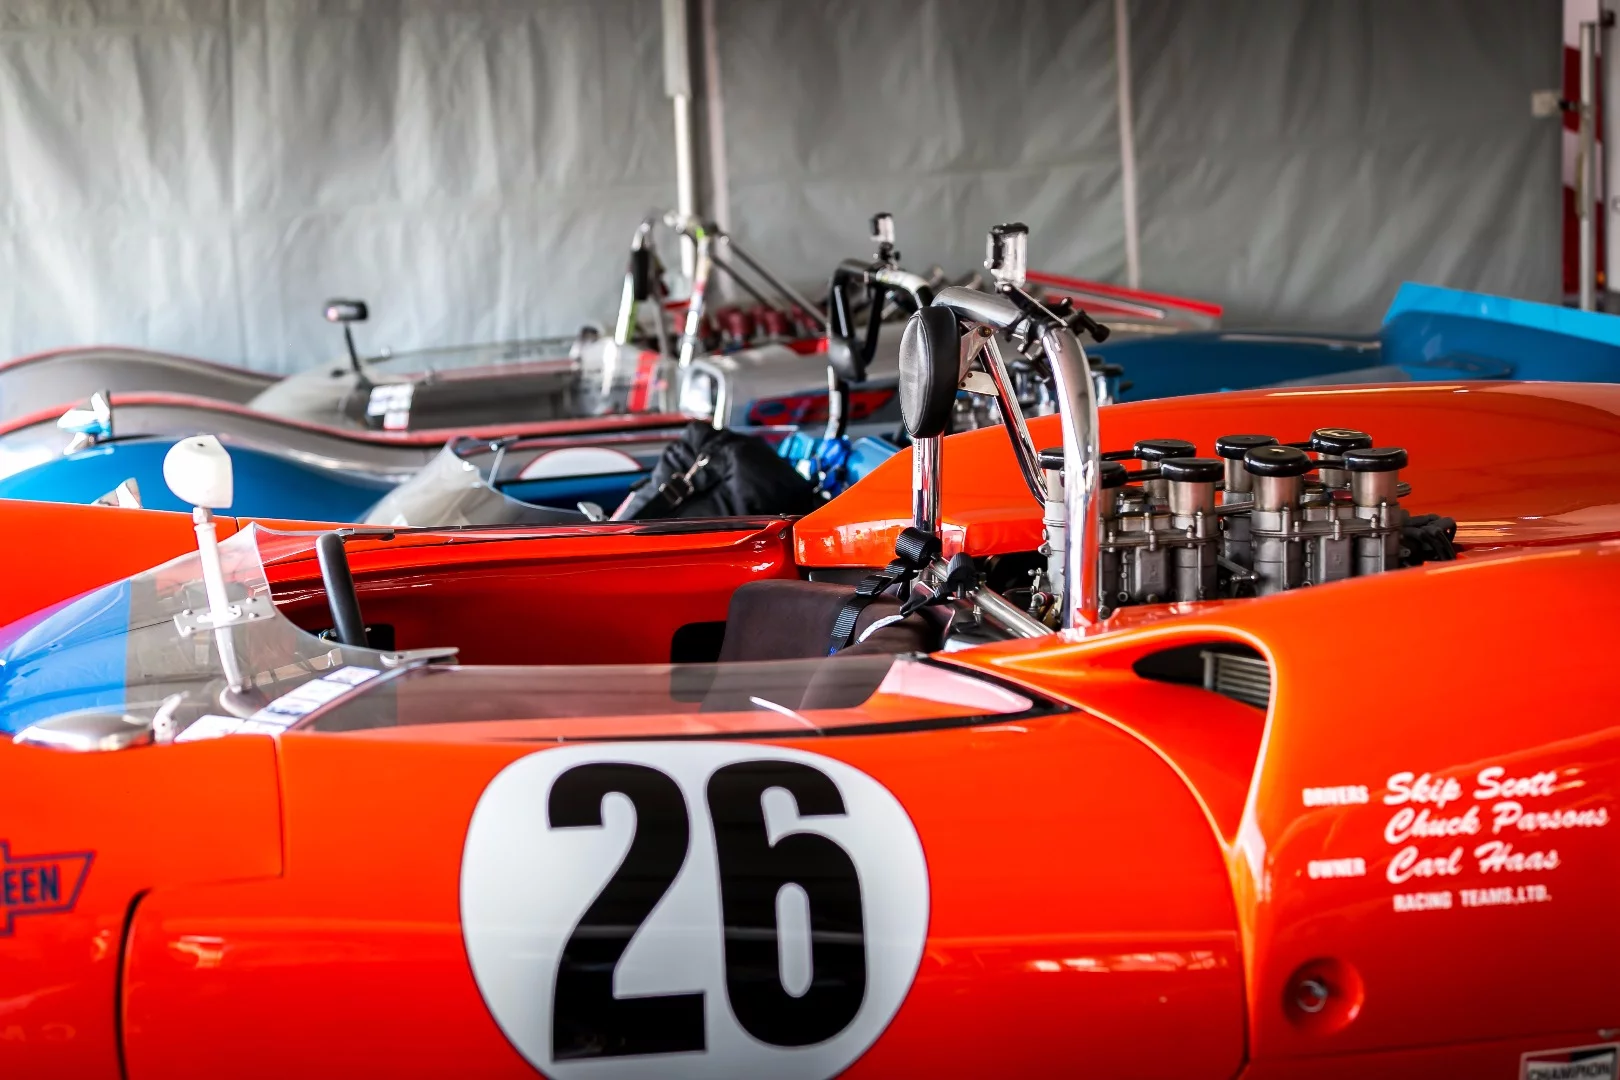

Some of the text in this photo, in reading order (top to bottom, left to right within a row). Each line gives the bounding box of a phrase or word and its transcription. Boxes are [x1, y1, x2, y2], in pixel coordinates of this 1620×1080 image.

[1302, 766, 1557, 807] DRIVERS Skip Scott
[1384, 801, 1608, 845] Chuck Parsons
[1307, 840, 1558, 884] OWNER Carl Haas
[0, 866, 59, 905] EEN
[1393, 891, 1452, 912] RACING
[548, 760, 867, 1062] 26
